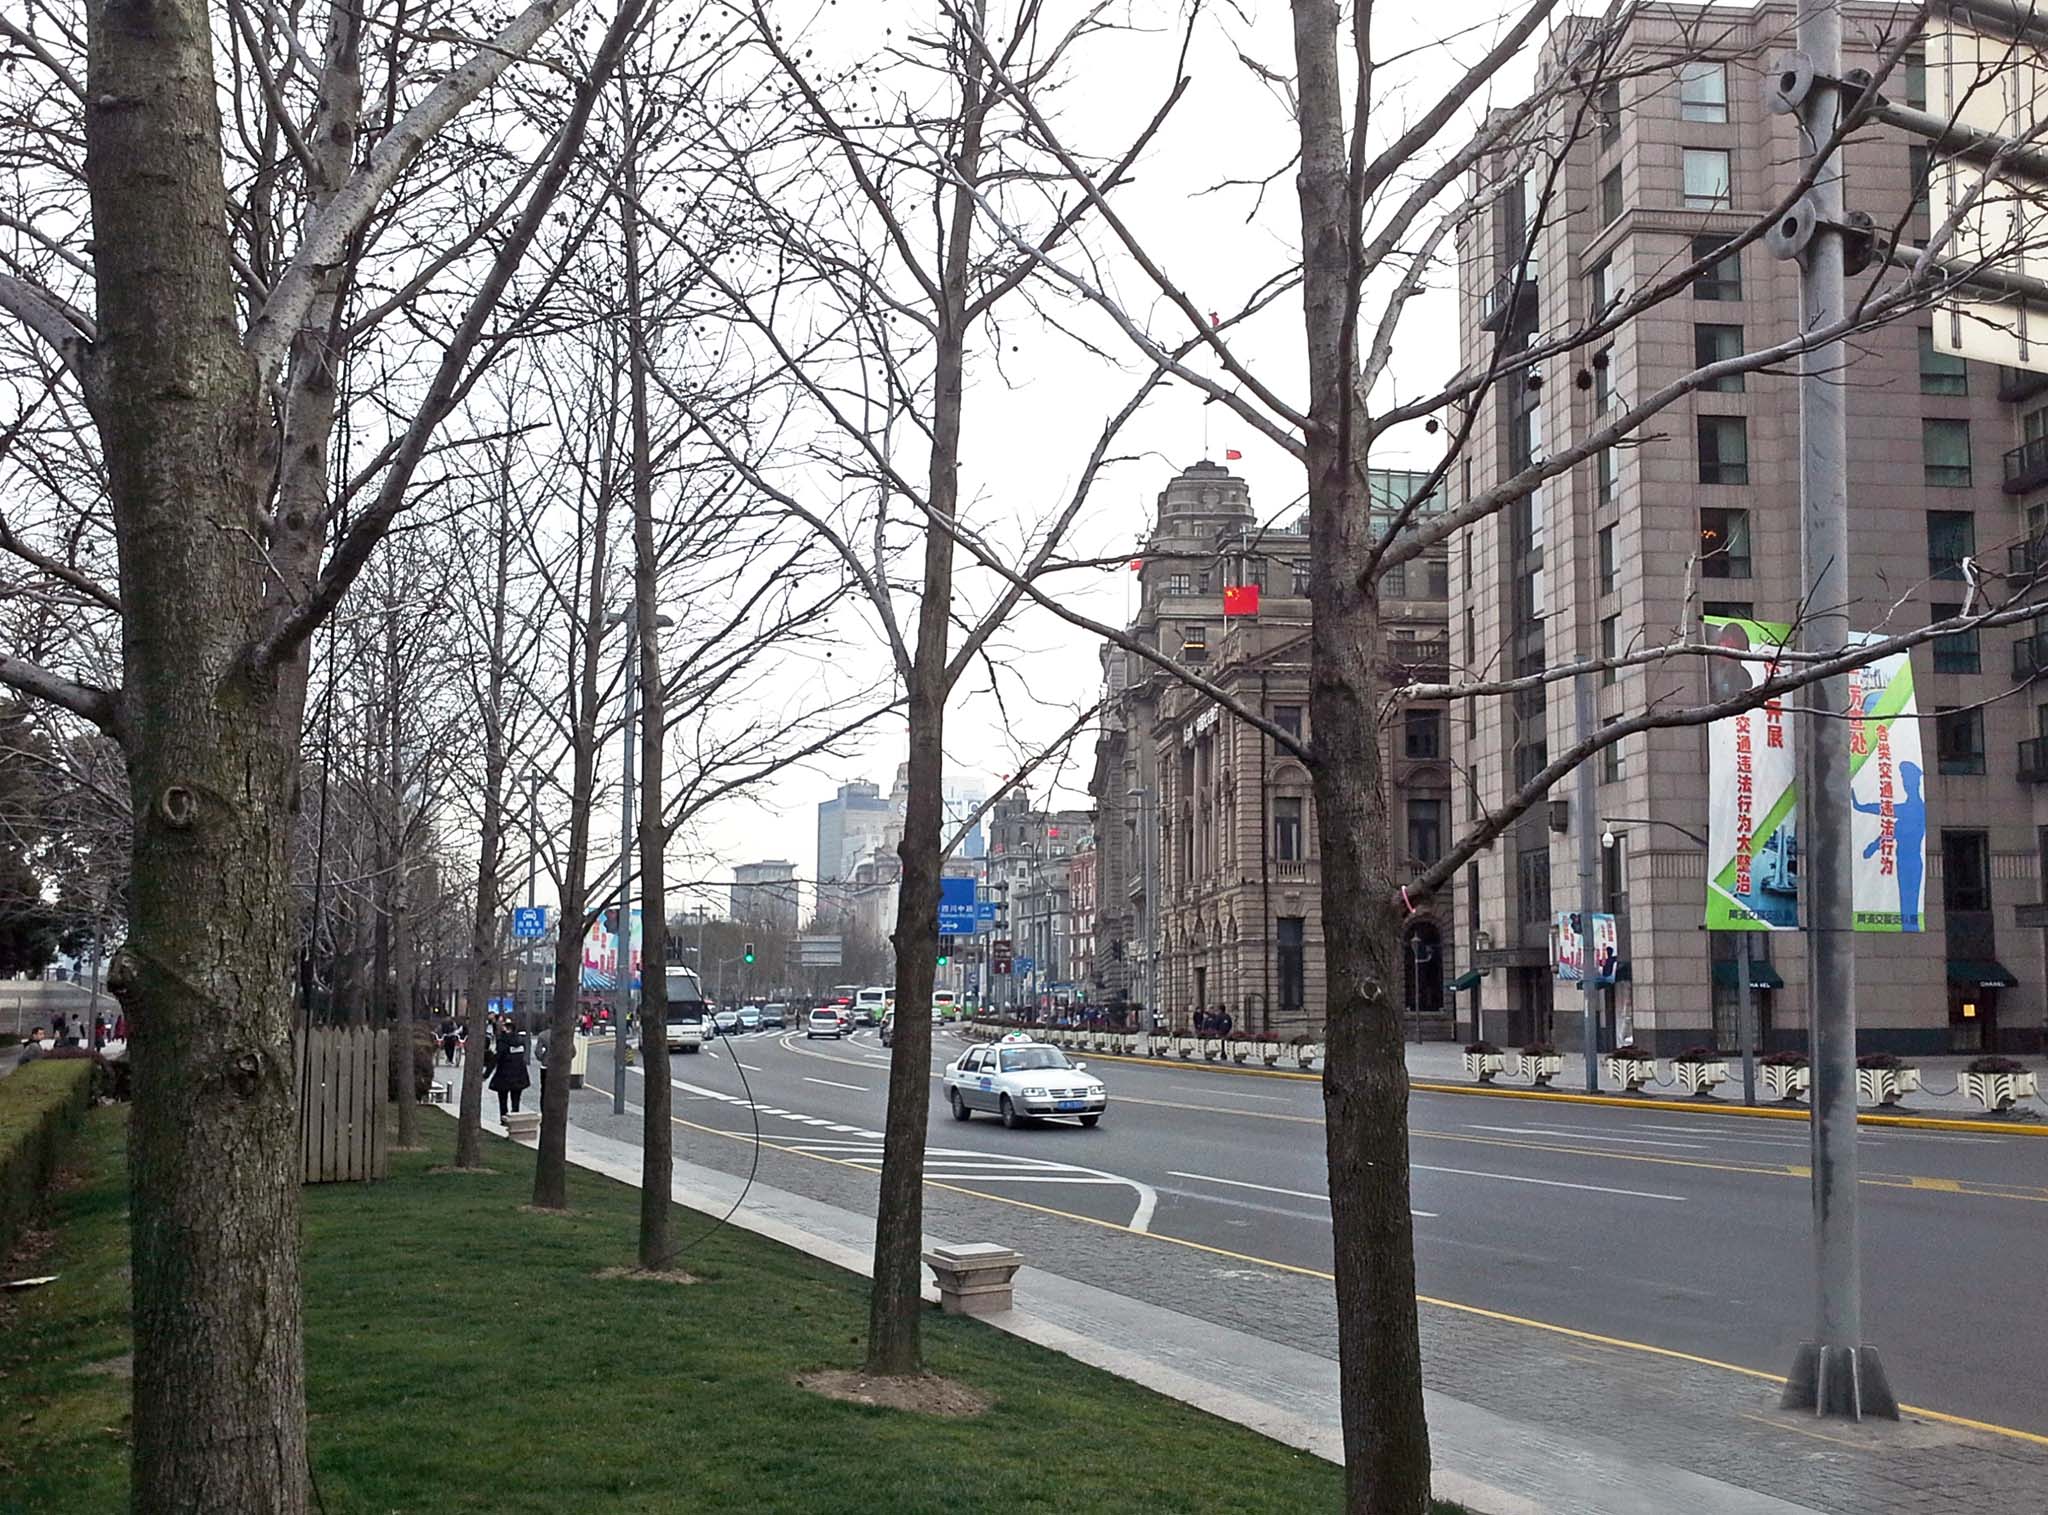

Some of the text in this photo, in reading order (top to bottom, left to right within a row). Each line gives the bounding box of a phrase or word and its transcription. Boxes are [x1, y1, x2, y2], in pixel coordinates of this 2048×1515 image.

[1735, 715, 1751, 894] 交通违法行为大整治
[1876, 724, 1894, 876] 各类交通违法行为
